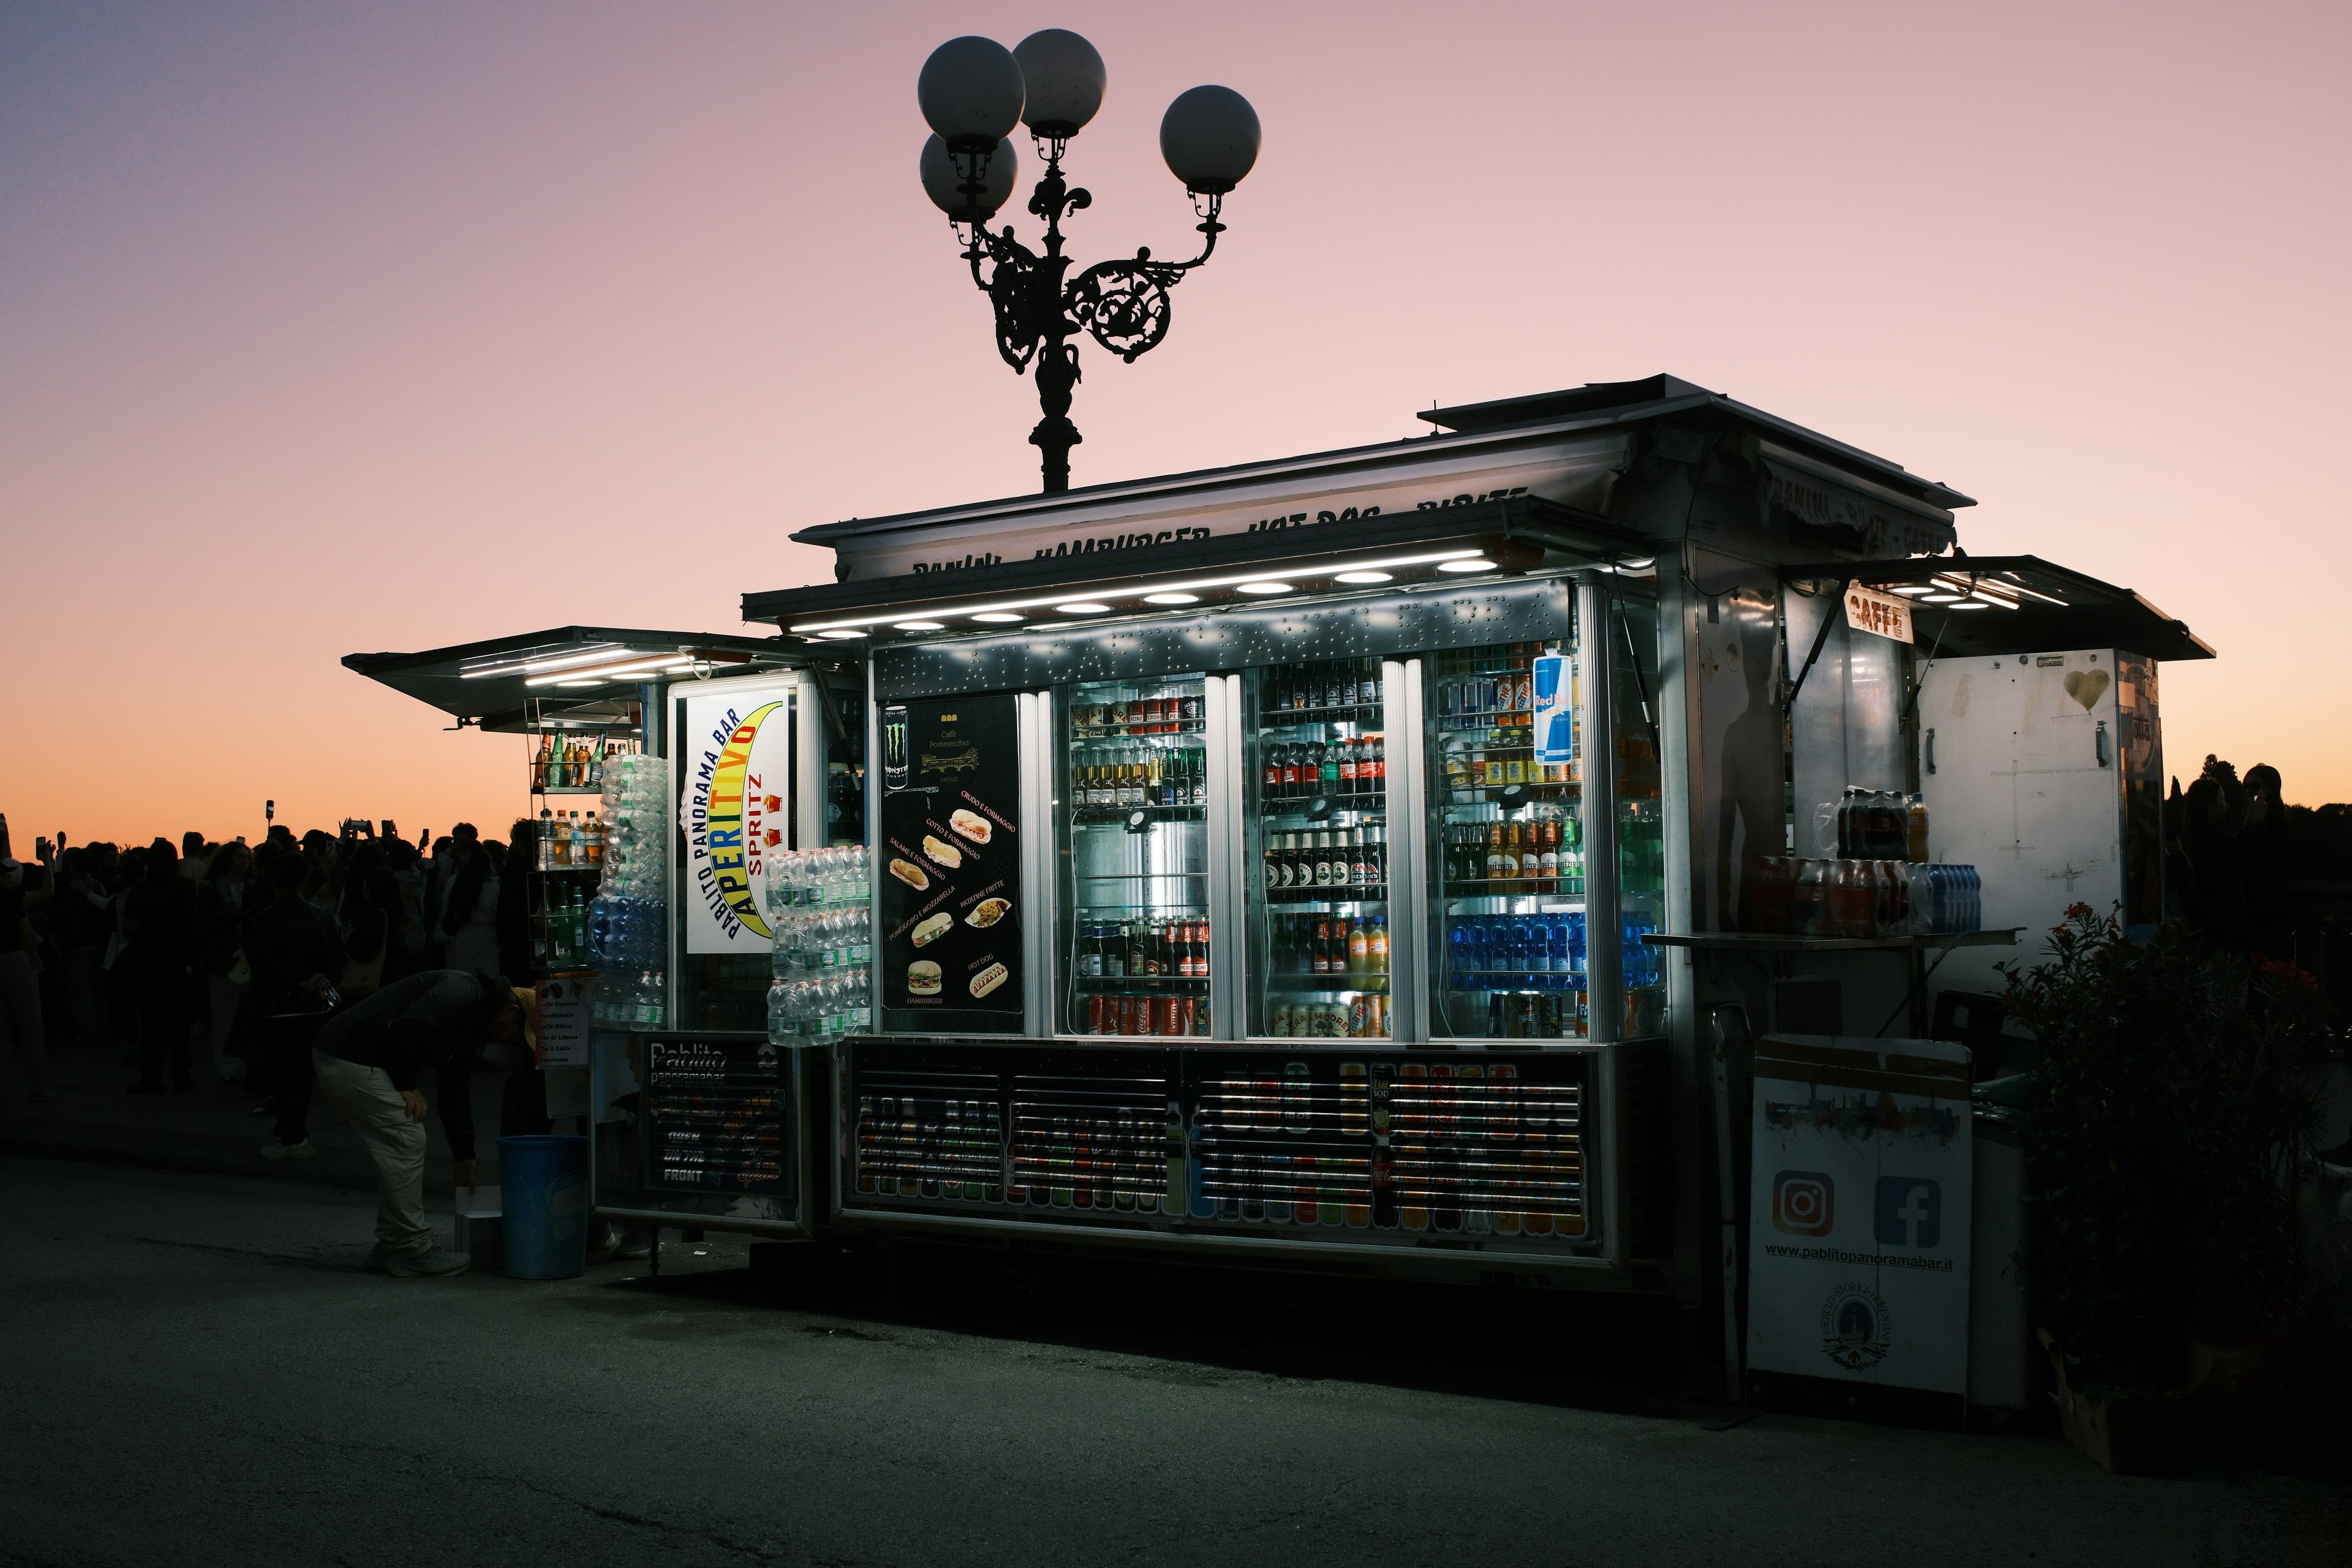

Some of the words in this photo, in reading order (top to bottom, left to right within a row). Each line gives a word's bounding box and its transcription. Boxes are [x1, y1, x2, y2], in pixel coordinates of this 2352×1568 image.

[1536, 693, 1553, 706] Red
[1555, 693, 1570, 706] Bull
[712, 707, 742, 747] BAR
[930, 739, 969, 748] Pontevecchio
[692, 750, 719, 861] PANORAMA
[708, 725, 758, 918] APERITIVO
[748, 773, 762, 876] SPRITZ
[960, 790, 980, 807] CRUDO
[984, 806, 1016, 833] FORMAGGIO
[889, 837, 911, 856] SALAME
[913, 854, 946, 881] FORMAGGIO
[926, 818, 944, 834] COTTO
[948, 833, 980, 860] FORMAGGIO
[698, 867, 741, 941] PABLITO
[889, 914, 919, 941] POMODORO
[922, 885, 956, 913] MOZZARELLA
[960, 889, 986, 908] PATATINE
[985, 879, 1005, 894] FRITTE
[968, 960, 981, 971] HOT
[980, 953, 994, 964] DOG
[664, 1169, 704, 1183] FRONT
[1765, 1243, 1954, 1272] www.pablitopanoramabar.it
